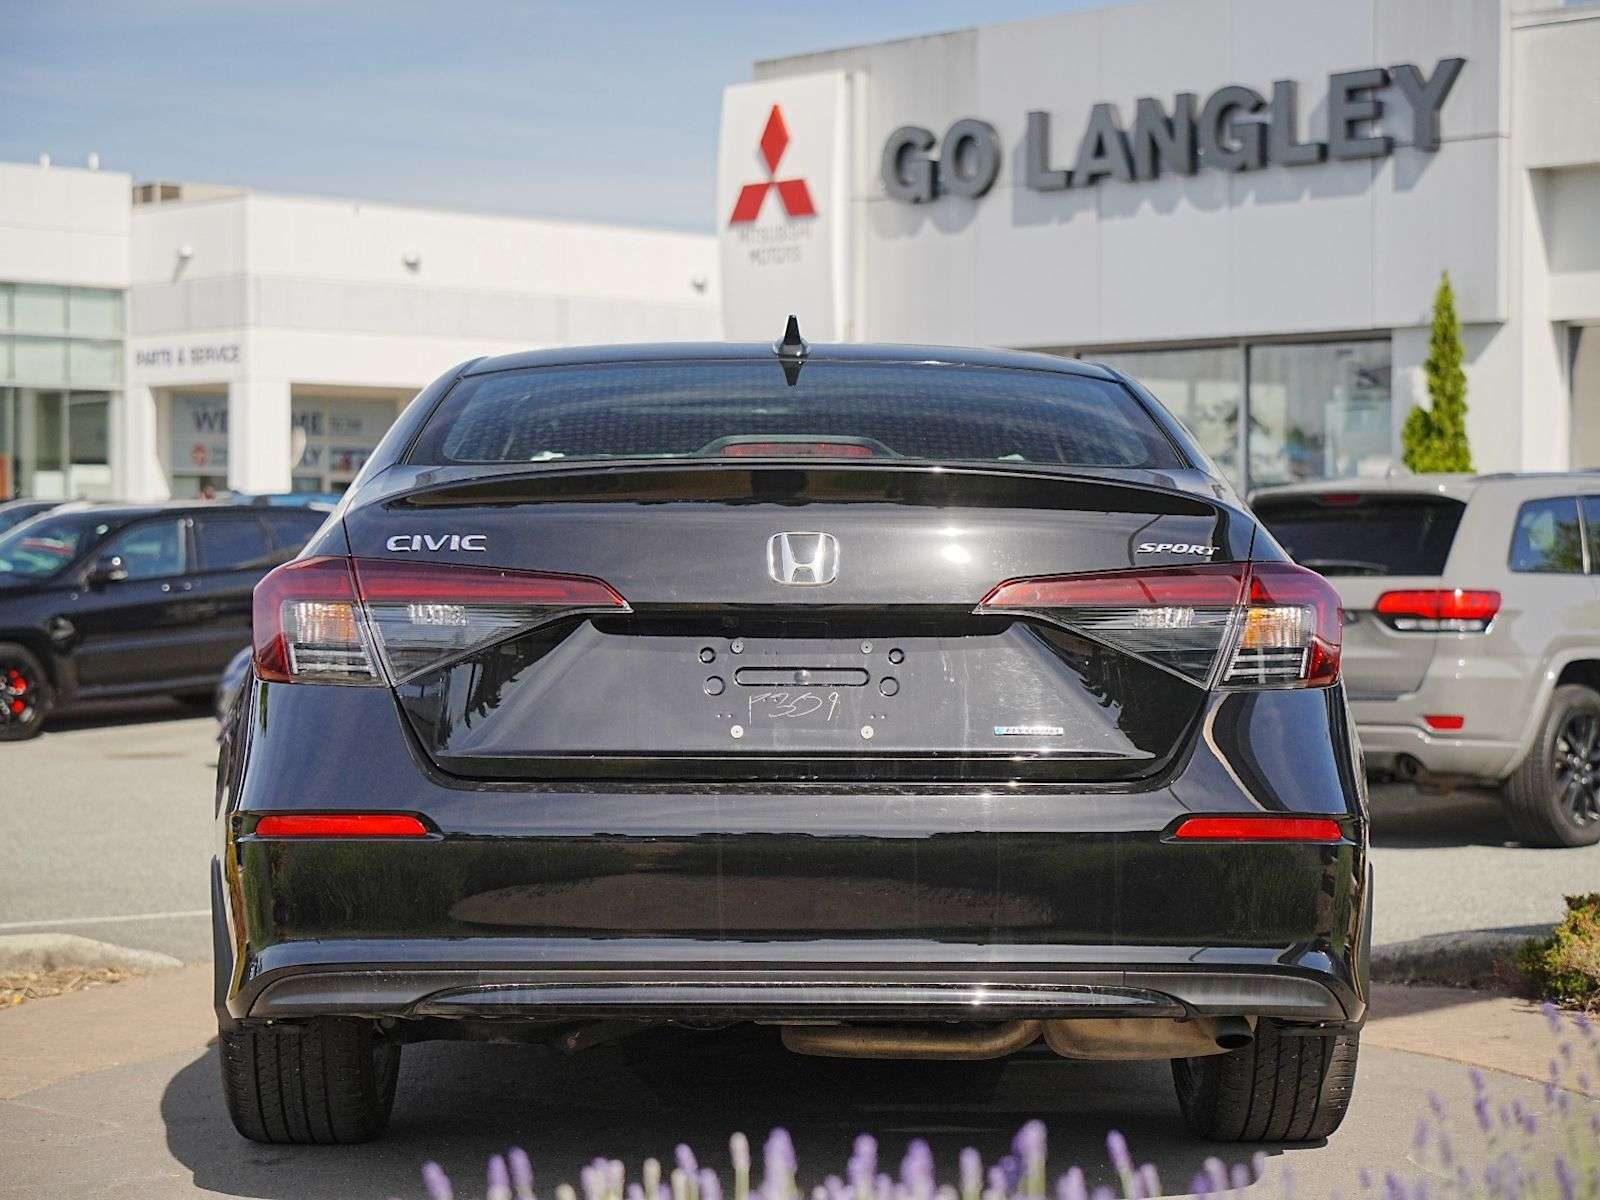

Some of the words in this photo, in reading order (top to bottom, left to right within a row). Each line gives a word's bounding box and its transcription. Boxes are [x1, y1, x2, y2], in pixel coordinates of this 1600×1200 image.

[882, 118, 1003, 204] GO
[1025, 57, 1466, 193] LANGLEY
[136, 350, 172, 368] PARTS
[191, 344, 240, 365] SERVICE
[386, 535, 487, 551] CIVIC
[1136, 543, 1220, 556] SPORT
